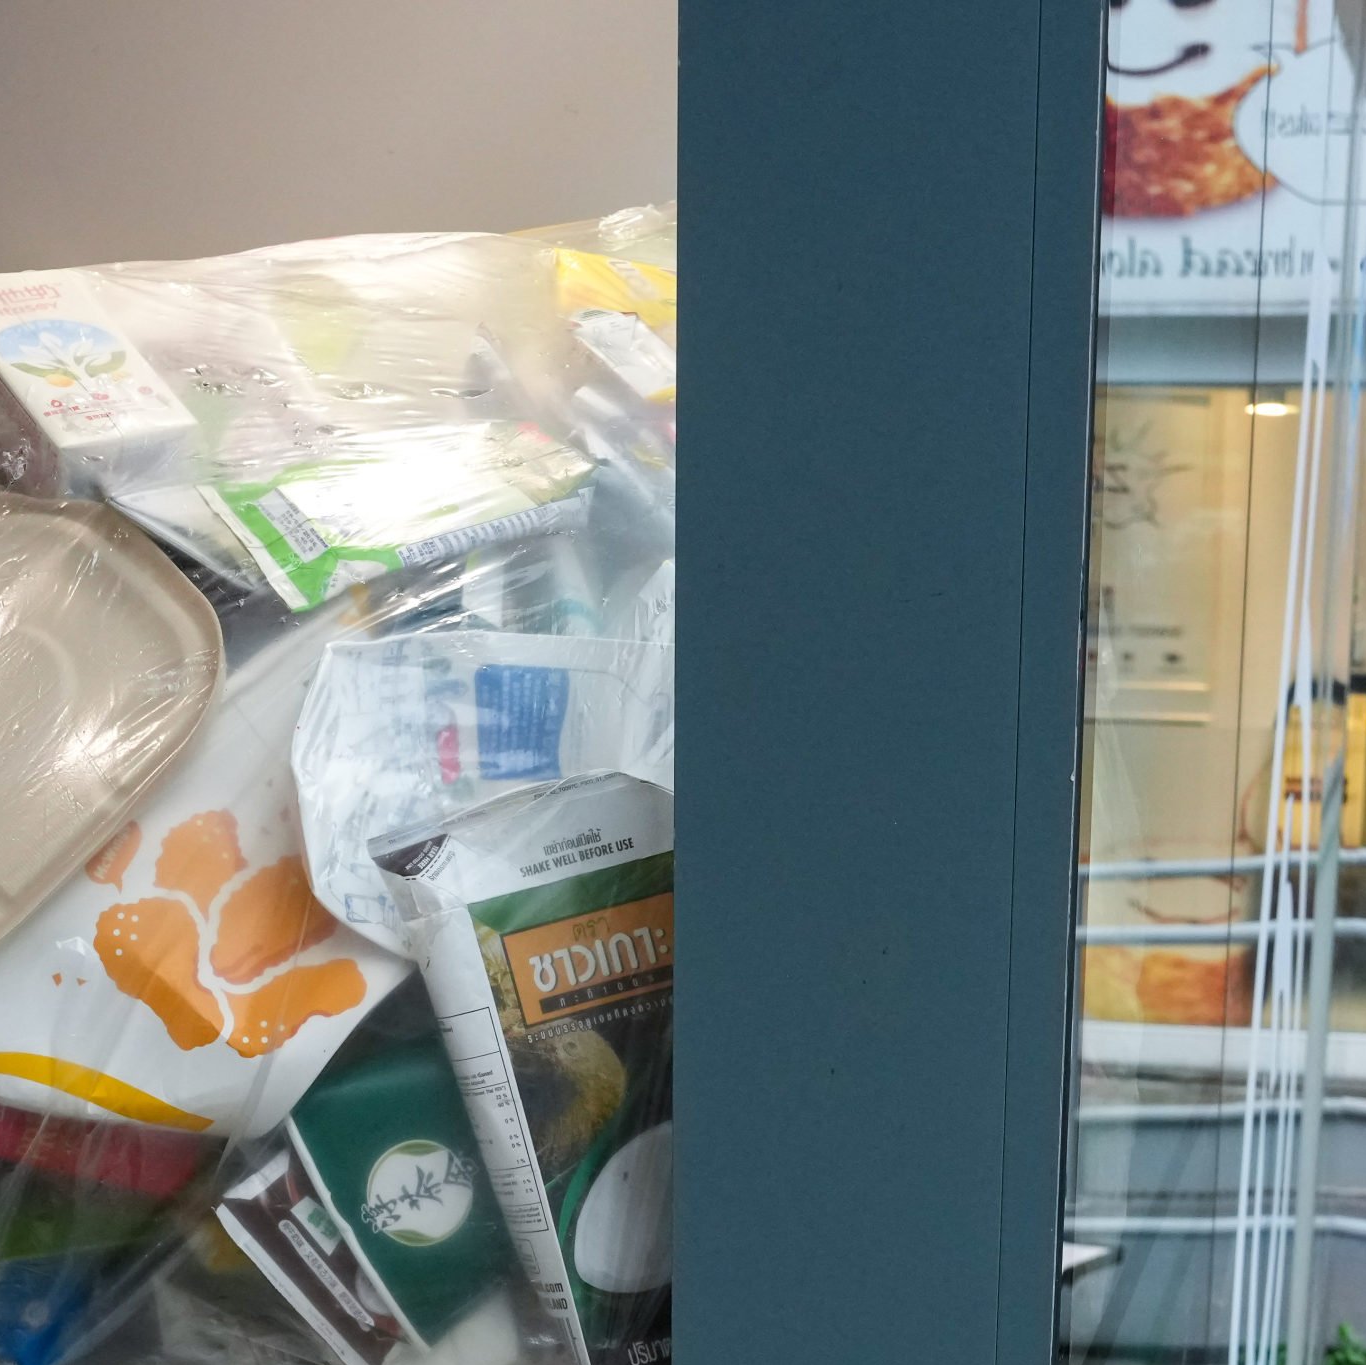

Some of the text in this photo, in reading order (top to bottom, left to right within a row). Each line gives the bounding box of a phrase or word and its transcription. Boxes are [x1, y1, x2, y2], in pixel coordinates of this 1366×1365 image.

[417, 856, 430, 870] HERE
[519, 836, 634, 877] SHAKE WELL BEFORE USE
[528, 924, 670, 995] ชาวเกาะ
